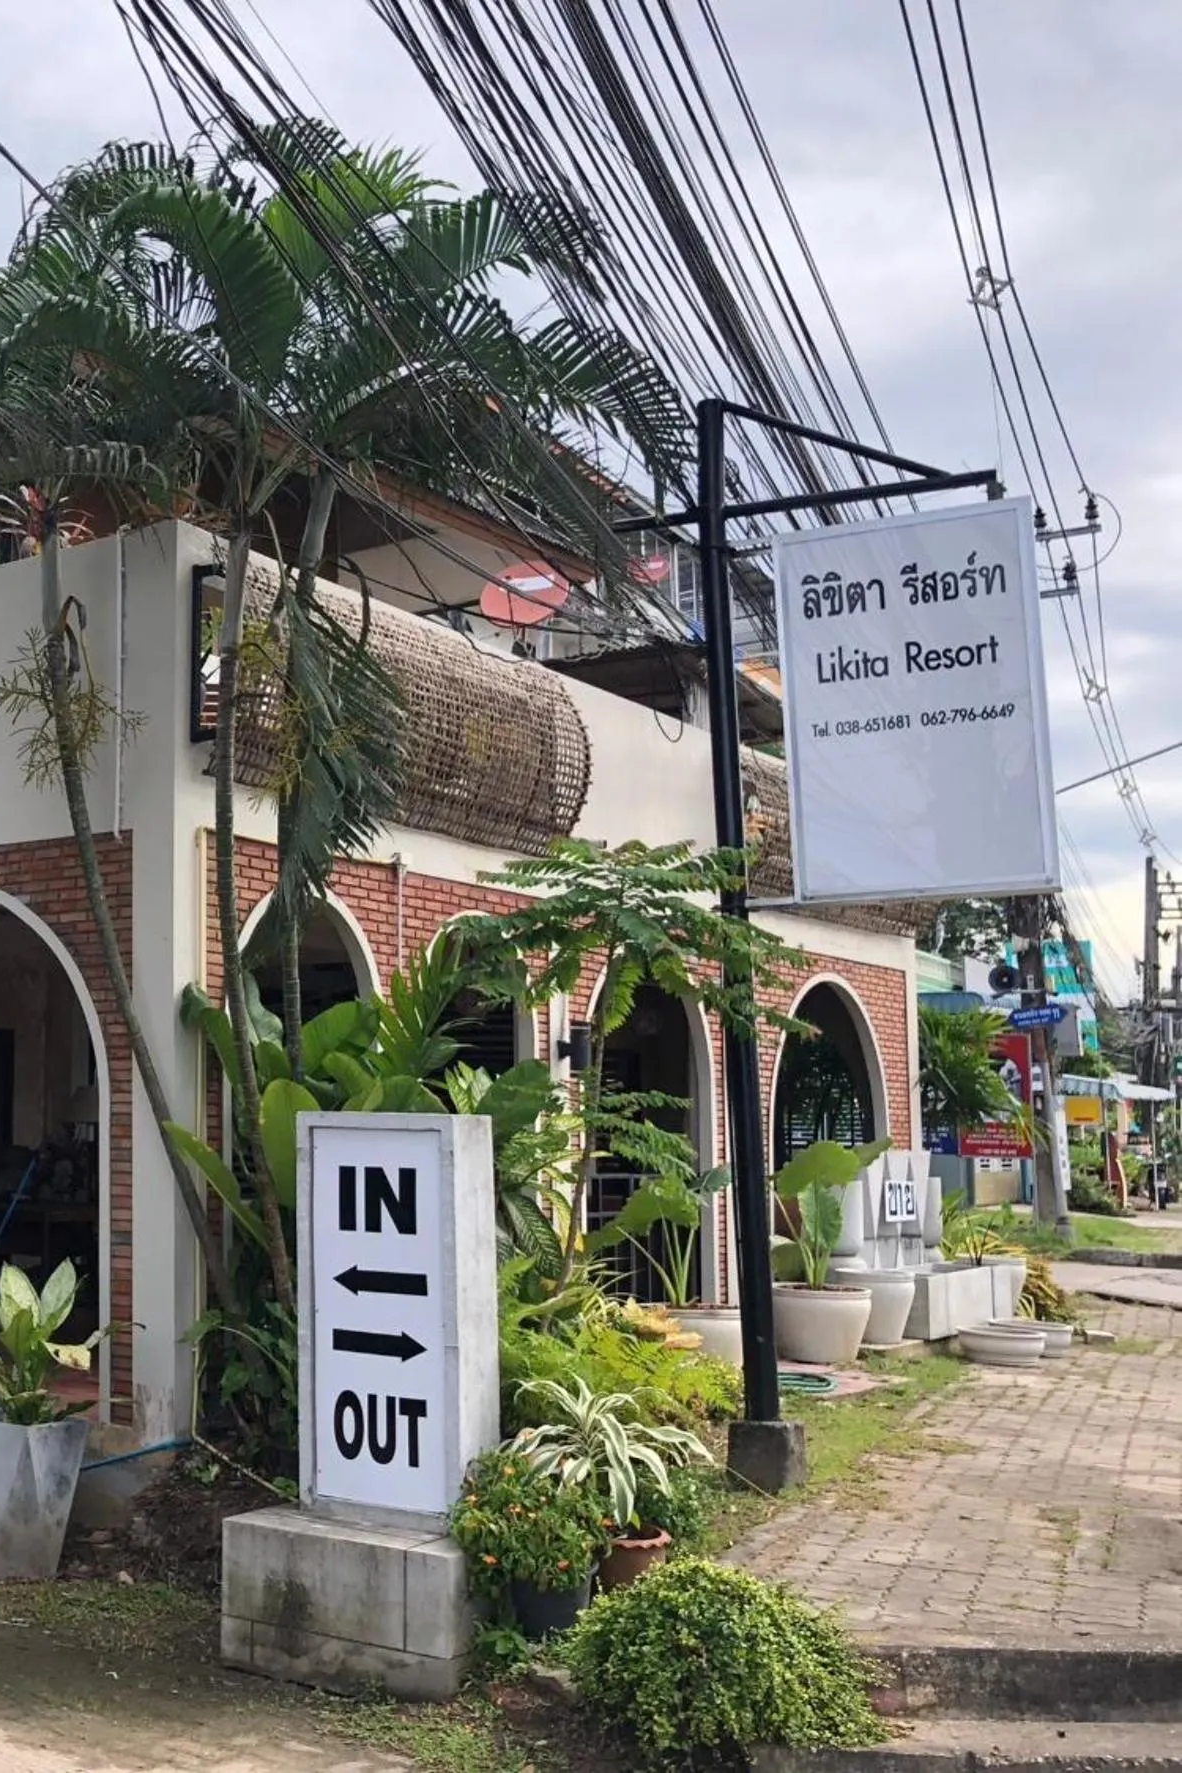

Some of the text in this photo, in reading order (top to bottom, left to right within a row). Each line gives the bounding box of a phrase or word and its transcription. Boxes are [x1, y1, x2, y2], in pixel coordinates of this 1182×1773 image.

[801, 551, 1006, 620] ลิขิตา รีสอร์ท
[816, 635, 999, 684] Likita Resort
[812, 702, 1015, 738] Tel. 038-651681 062-796-6649
[338, 1165, 417, 1235] IN
[888, 1183, 915, 1216] ขาย
[333, 1389, 428, 1468] OUT
